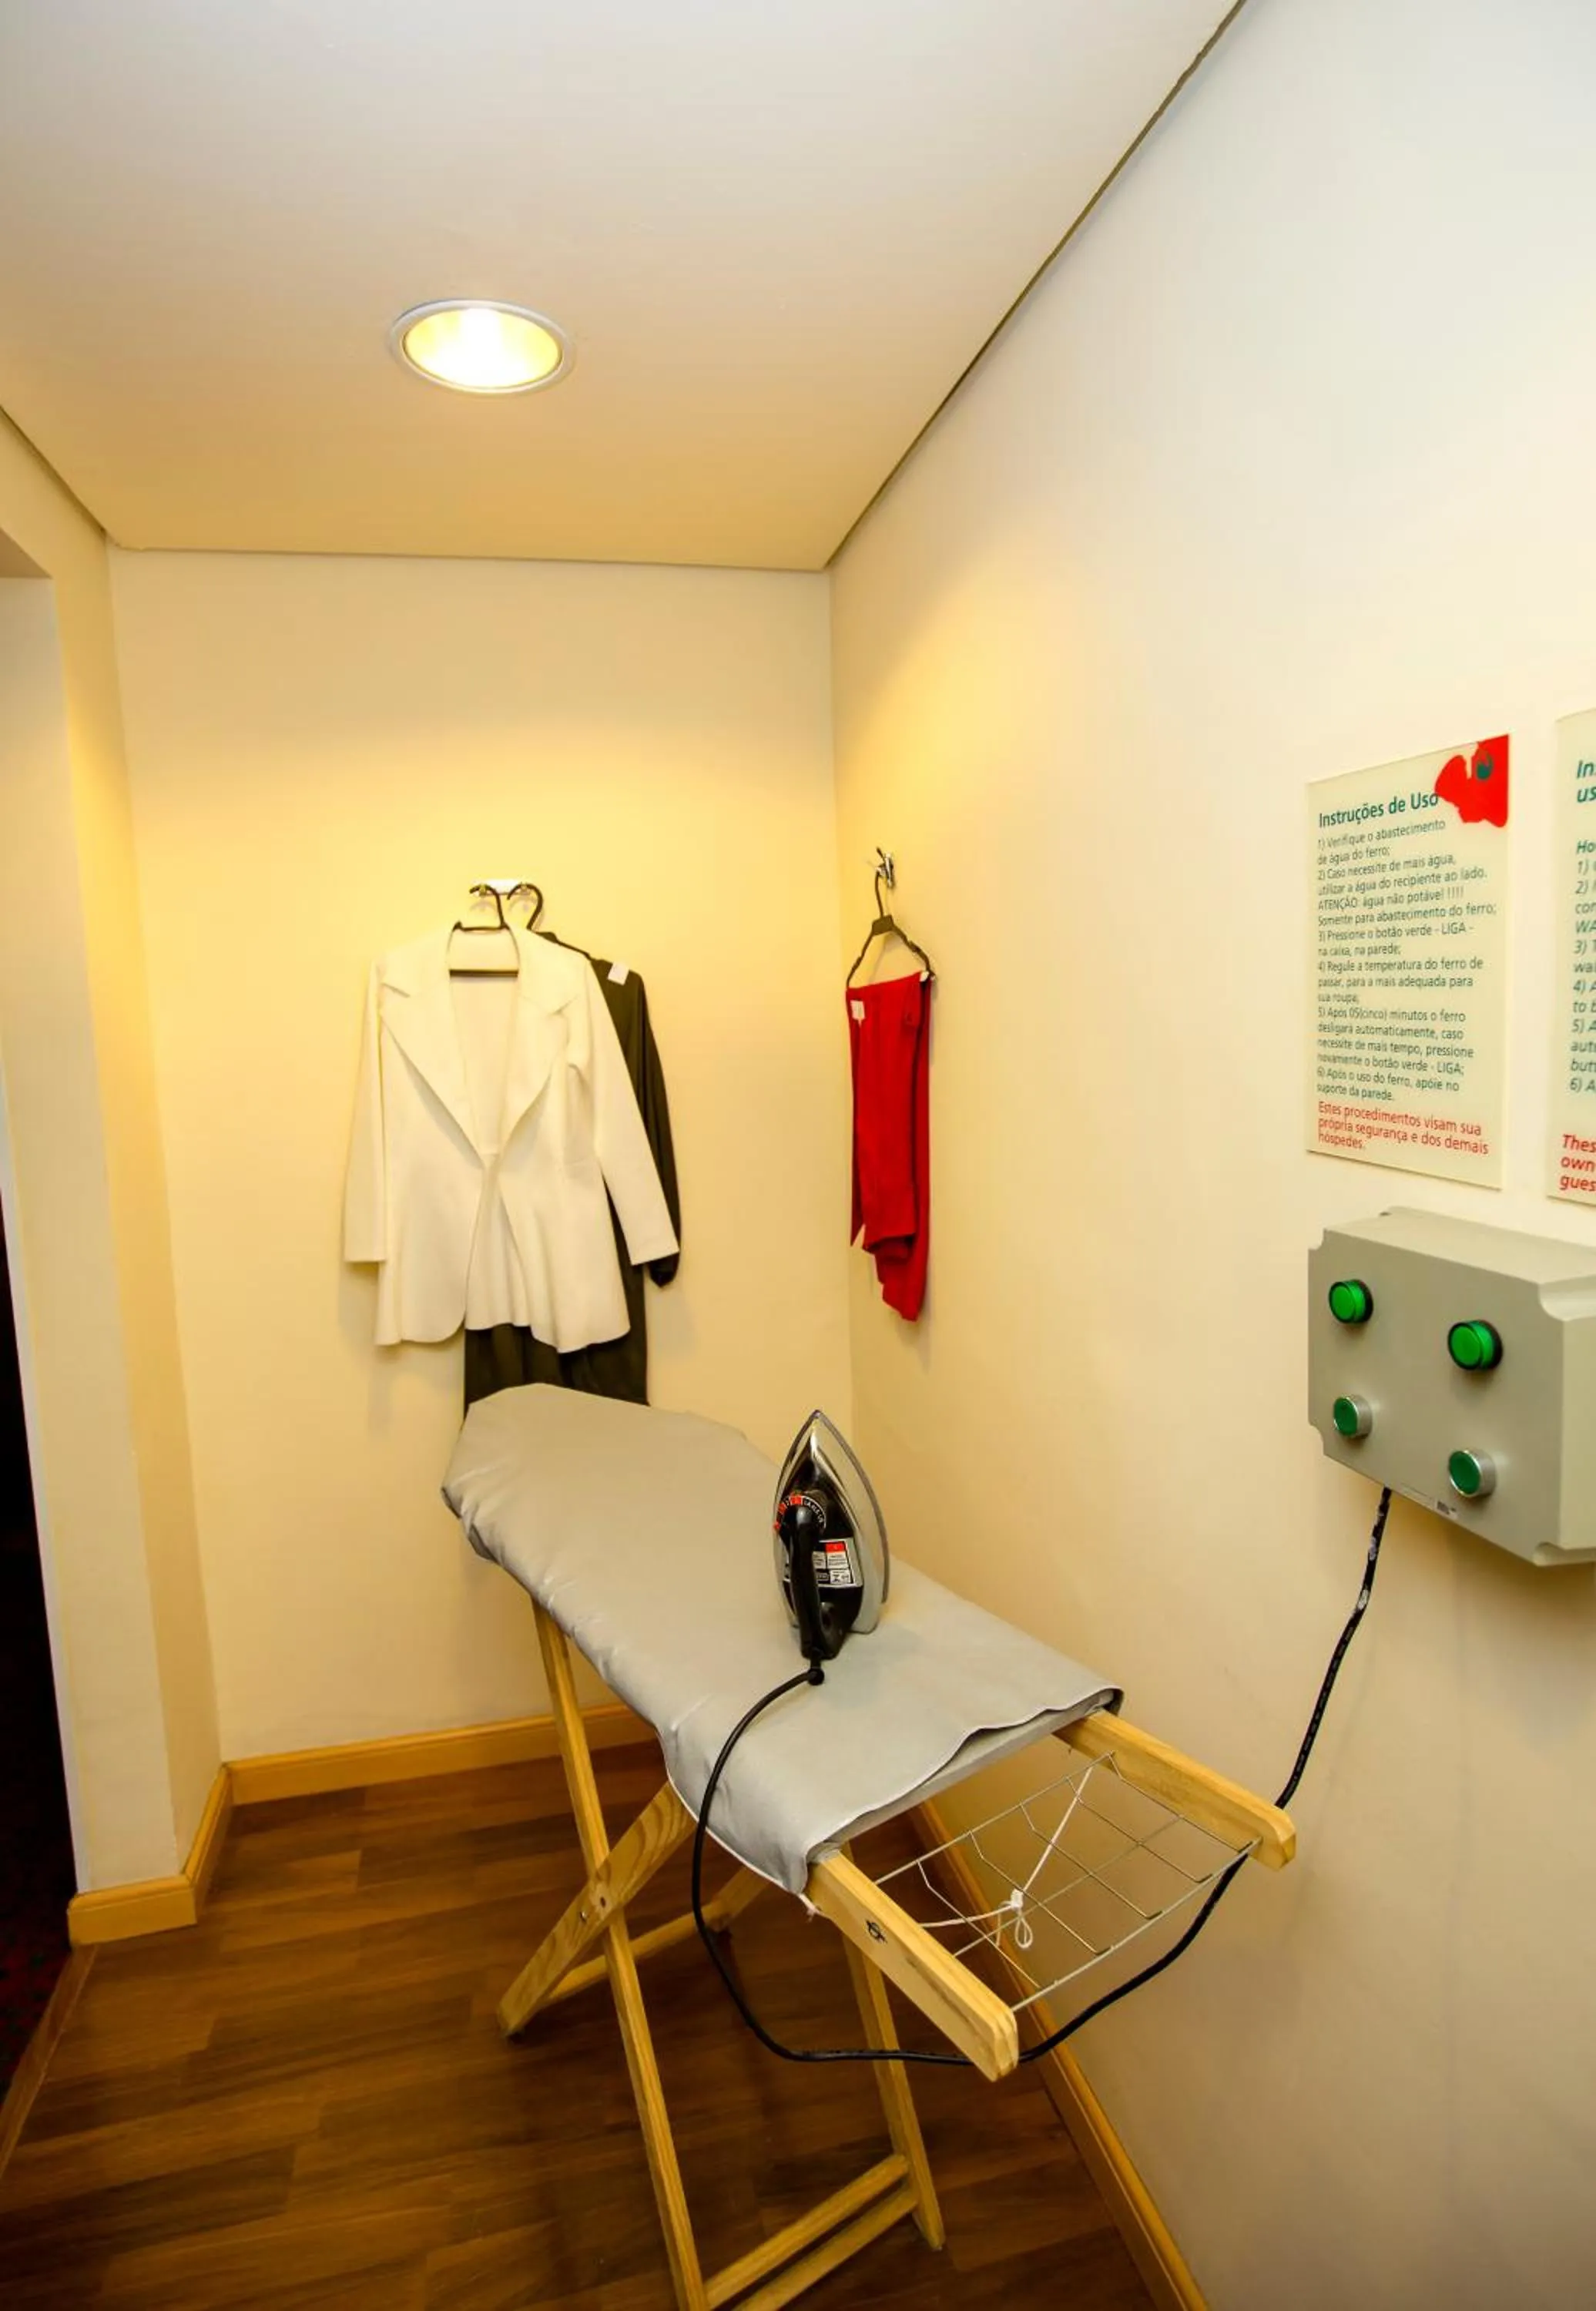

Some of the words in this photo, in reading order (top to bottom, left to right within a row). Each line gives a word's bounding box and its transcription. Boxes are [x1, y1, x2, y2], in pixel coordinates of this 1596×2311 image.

[1576, 760, 1596, 779] In
[1319, 803, 1384, 828] Instruções
[1388, 797, 1406, 813] de
[1411, 792, 1438, 810] Uso
[1327, 833, 1366, 849] Verifique
[1367, 834, 1373, 842] o
[1376, 820, 1446, 840] abastecimento
[1317, 854, 1326, 865] de
[1329, 852, 1350, 866] água
[1352, 849, 1363, 860] do
[1318, 870, 1326, 881] 2)
[1327, 868, 1346, 879] Caso
[1347, 862, 1386, 876] necessite
[1389, 860, 1401, 871] de
[1403, 857, 1426, 870] mais
[1318, 882, 1345, 896] utilizar
[1347, 884, 1353, 893] a
[1355, 880, 1376, 894] água
[1379, 877, 1391, 888] do
[1393, 870, 1441, 888] recipiente
[1444, 872, 1457, 882] ao
[1363, 894, 1384, 909] água
[1386, 893, 1404, 904] não
[1407, 887, 1444, 906] potável
[1318, 914, 1353, 927] Somente
[1355, 913, 1374, 924] para
[1376, 907, 1446, 923] abastecimento
[1448, 904, 1463, 916] do
[1327, 929, 1366, 942] Pressione
[1367, 930, 1373, 939] o
[1376, 926, 1403, 938] botão
[1405, 924, 1432, 937] verde
[1441, 921, 1467, 934] LIGA
[1318, 948, 1328, 956] na
[1354, 947, 1366, 956] na
[1327, 960, 1355, 974] Regule
[1357, 962, 1362, 971] a
[1364, 959, 1421, 973] temperatura
[1424, 958, 1438, 970] do
[1440, 956, 1467, 970] ferro
[1470, 956, 1484, 969] de
[1346, 978, 1366, 988] para
[1367, 978, 1373, 987] a
[1375, 976, 1396, 987] mais
[1398, 975, 1447, 990] adequada
[1449, 977, 1474, 990] para
[1318, 993, 1330, 1002] sua
[1327, 1007, 1346, 1020] Após
[1390, 1009, 1427, 1021] minutos
[1430, 1012, 1437, 1021] o
[1440, 1008, 1466, 1022] ferro
[1441, 1028, 1464, 1040] caso
[1318, 1038, 1353, 1050] necessite
[1355, 1039, 1366, 1050] de
[1367, 1040, 1387, 1052] mais
[1426, 1043, 1474, 1058] pressione
[1317, 1053, 1362, 1065] novamente
[1365, 1058, 1370, 1067] o
[1372, 1056, 1400, 1069] botão
[1401, 1060, 1428, 1072] verde
[1317, 1082, 1347, 1095] suporte
[1349, 1085, 1360, 1096] da
[1326, 1068, 1346, 1081] Após
[1349, 1072, 1354, 1080] o
[1356, 1072, 1371, 1082] uso
[1373, 1072, 1385, 1084] do
[1446, 1081, 1460, 1092] no
[1319, 1100, 1342, 1115] Estes
[1344, 1105, 1421, 1128] procedimentos
[1424, 1116, 1457, 1132] visam
[1460, 1121, 1482, 1136] sua
[1319, 1117, 1353, 1133] própria
[1355, 1123, 1408, 1144] segurança
[1411, 1132, 1418, 1141] e
[1421, 1131, 1441, 1147] dos
[1444, 1135, 1489, 1155] demais
[1561, 1156, 1595, 1172] own
